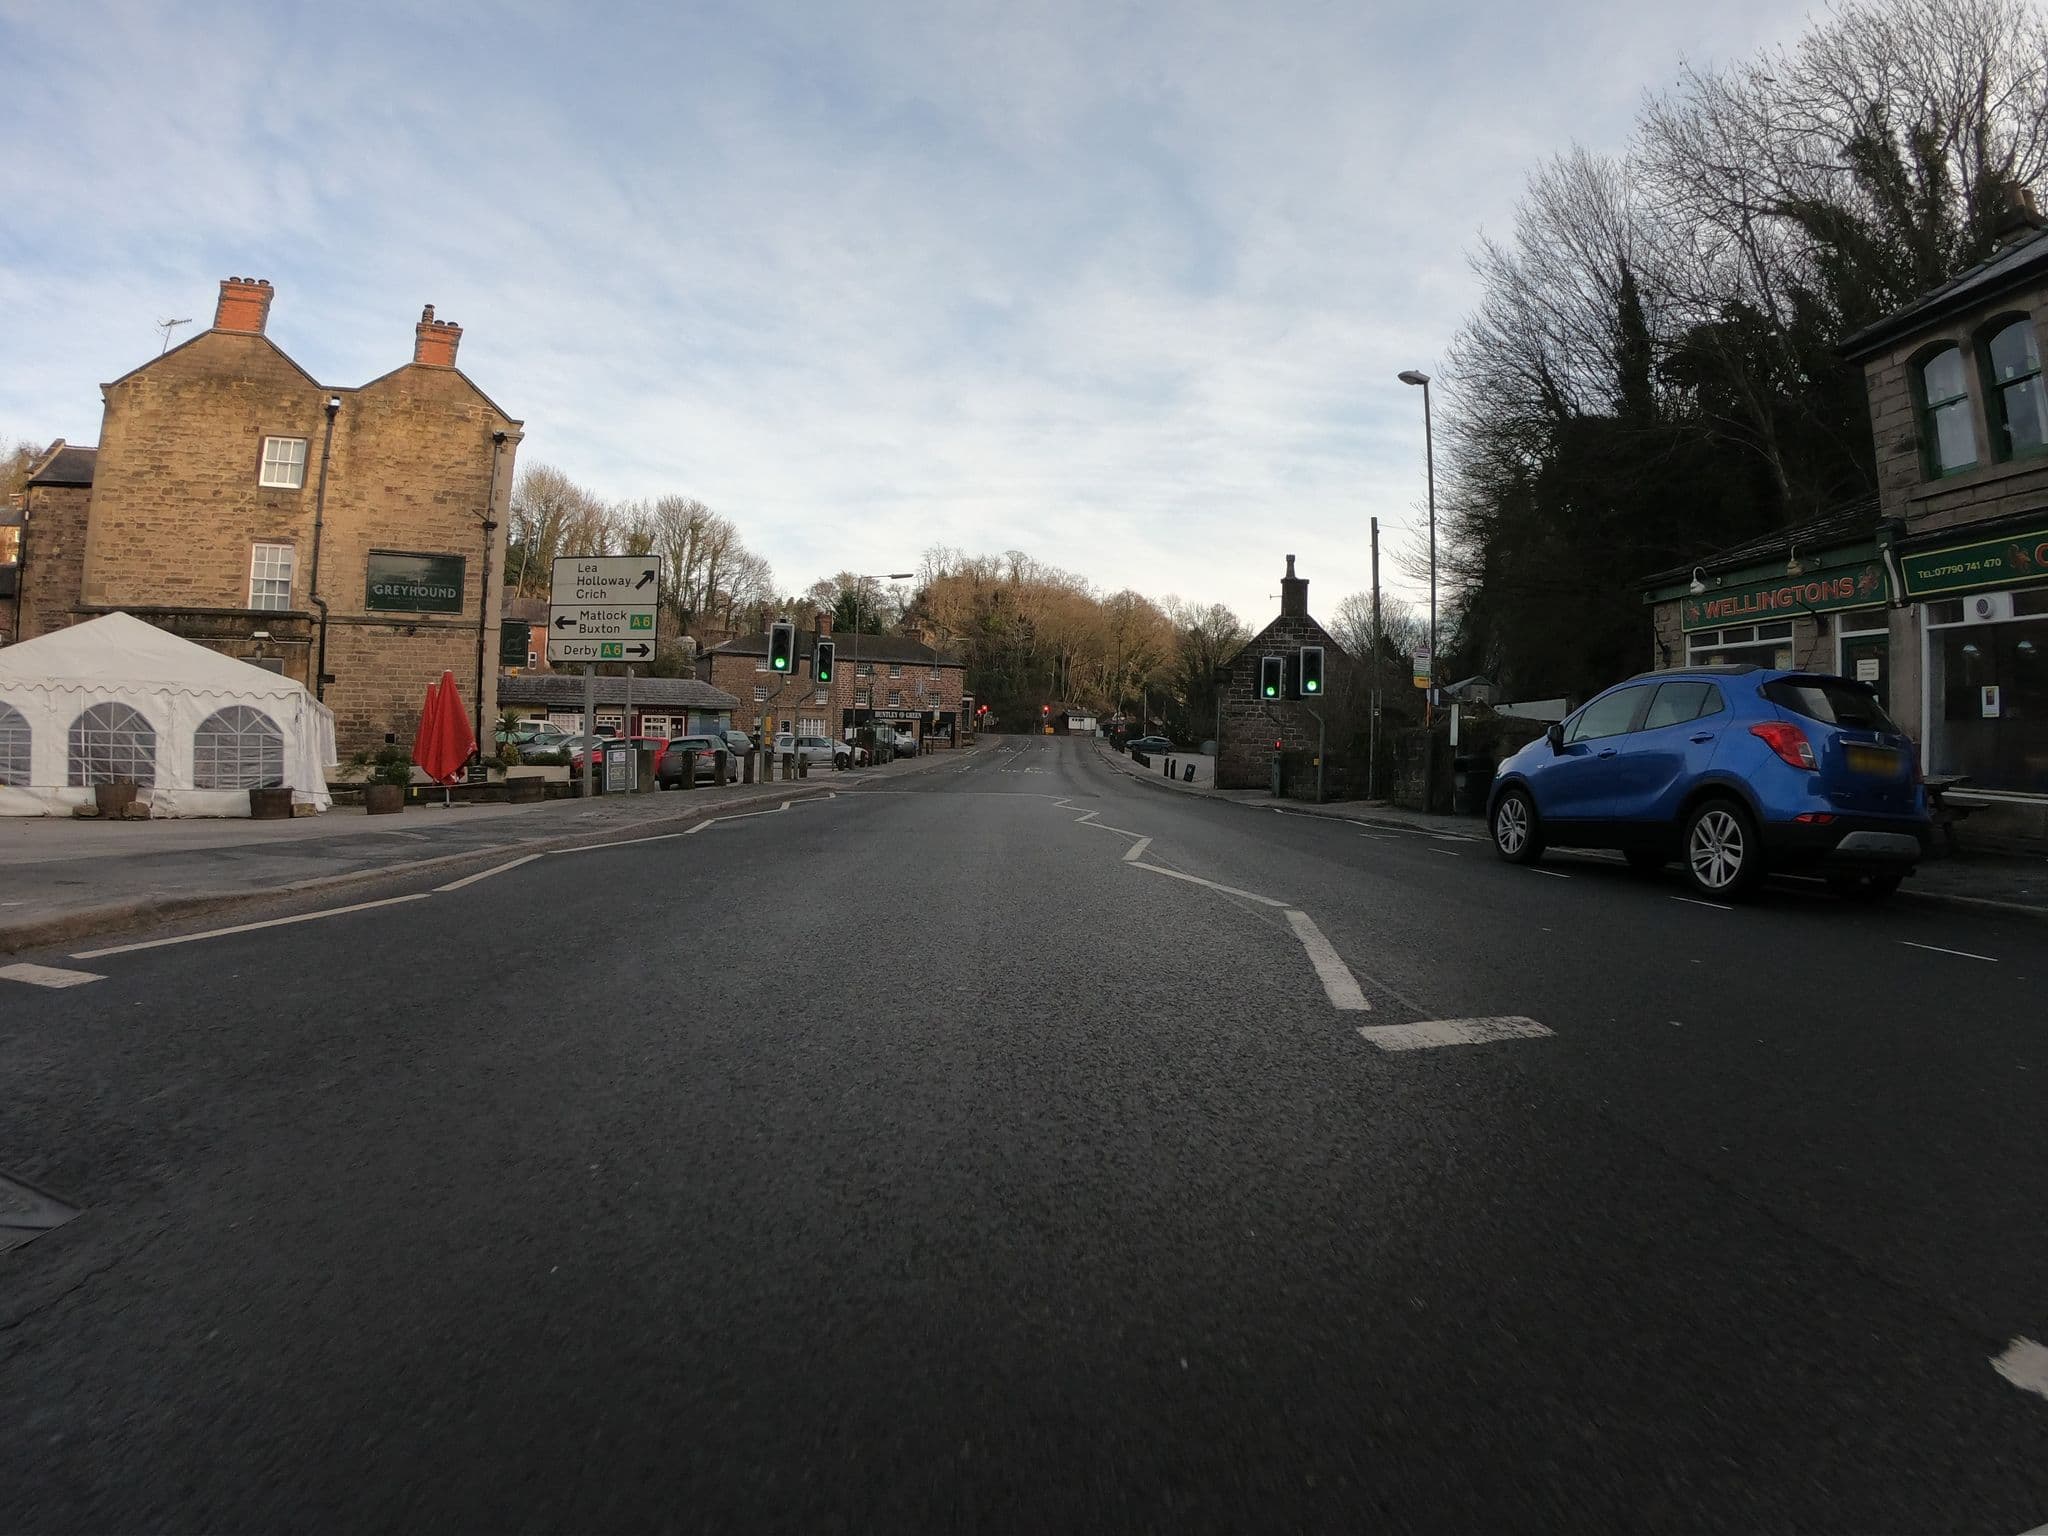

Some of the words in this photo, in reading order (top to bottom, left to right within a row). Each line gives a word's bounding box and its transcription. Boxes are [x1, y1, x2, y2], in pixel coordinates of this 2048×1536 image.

[578, 563, 598, 573] Lea
[1964, 561, 1981, 572] 741
[1983, 558, 2002, 569] 470
[576, 576, 631, 587] Holloway
[373, 584, 456, 599] GREYHOUND
[576, 589, 607, 599] Crich
[1703, 577, 1855, 619] WELLINGTONS
[579, 610, 627, 621] Matlock
[632, 617, 650, 627] A6
[579, 624, 620, 634] Buxton
[564, 645, 598, 657] Derby
[603, 644, 621, 655] A6
